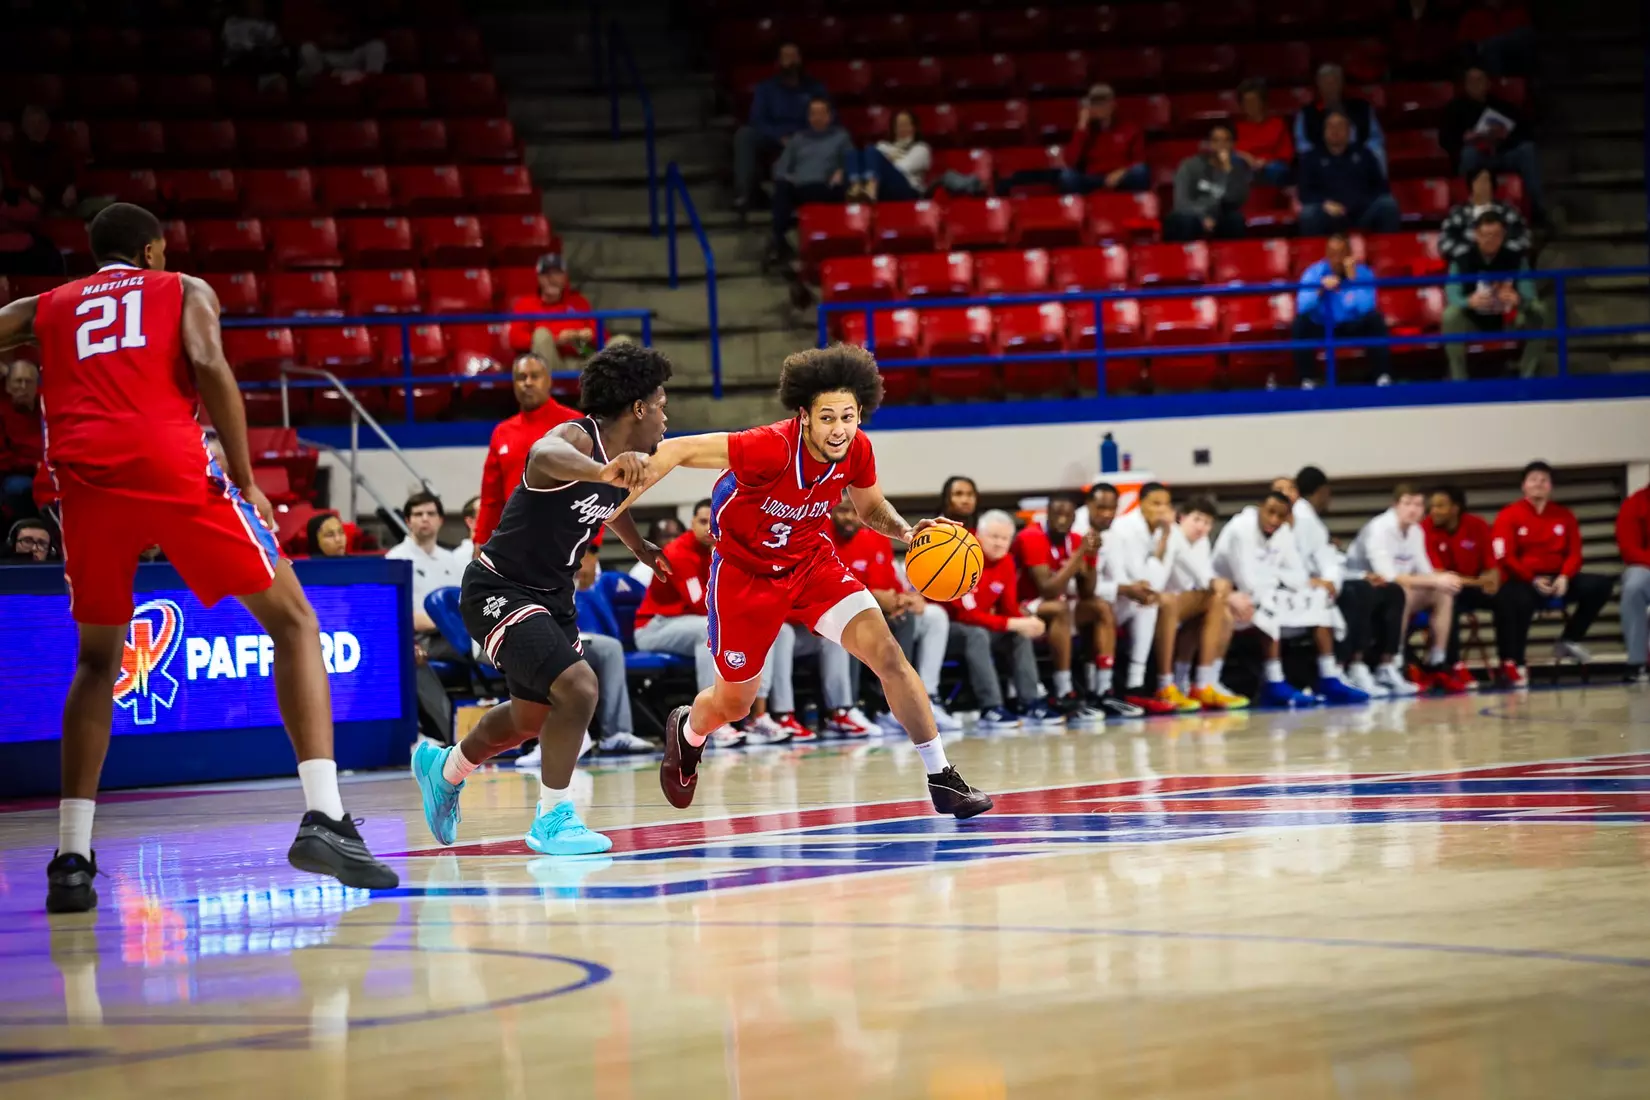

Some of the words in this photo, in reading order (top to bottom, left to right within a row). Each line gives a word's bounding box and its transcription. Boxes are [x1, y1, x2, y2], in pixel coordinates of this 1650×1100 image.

[81, 276, 145, 296] MARTINEZ
[76, 290, 147, 361] 21
[570, 493, 617, 524] Aggie
[565, 528, 591, 567] 1
[762, 522, 792, 548] 3
[186, 631, 361, 680] PAFFRD
